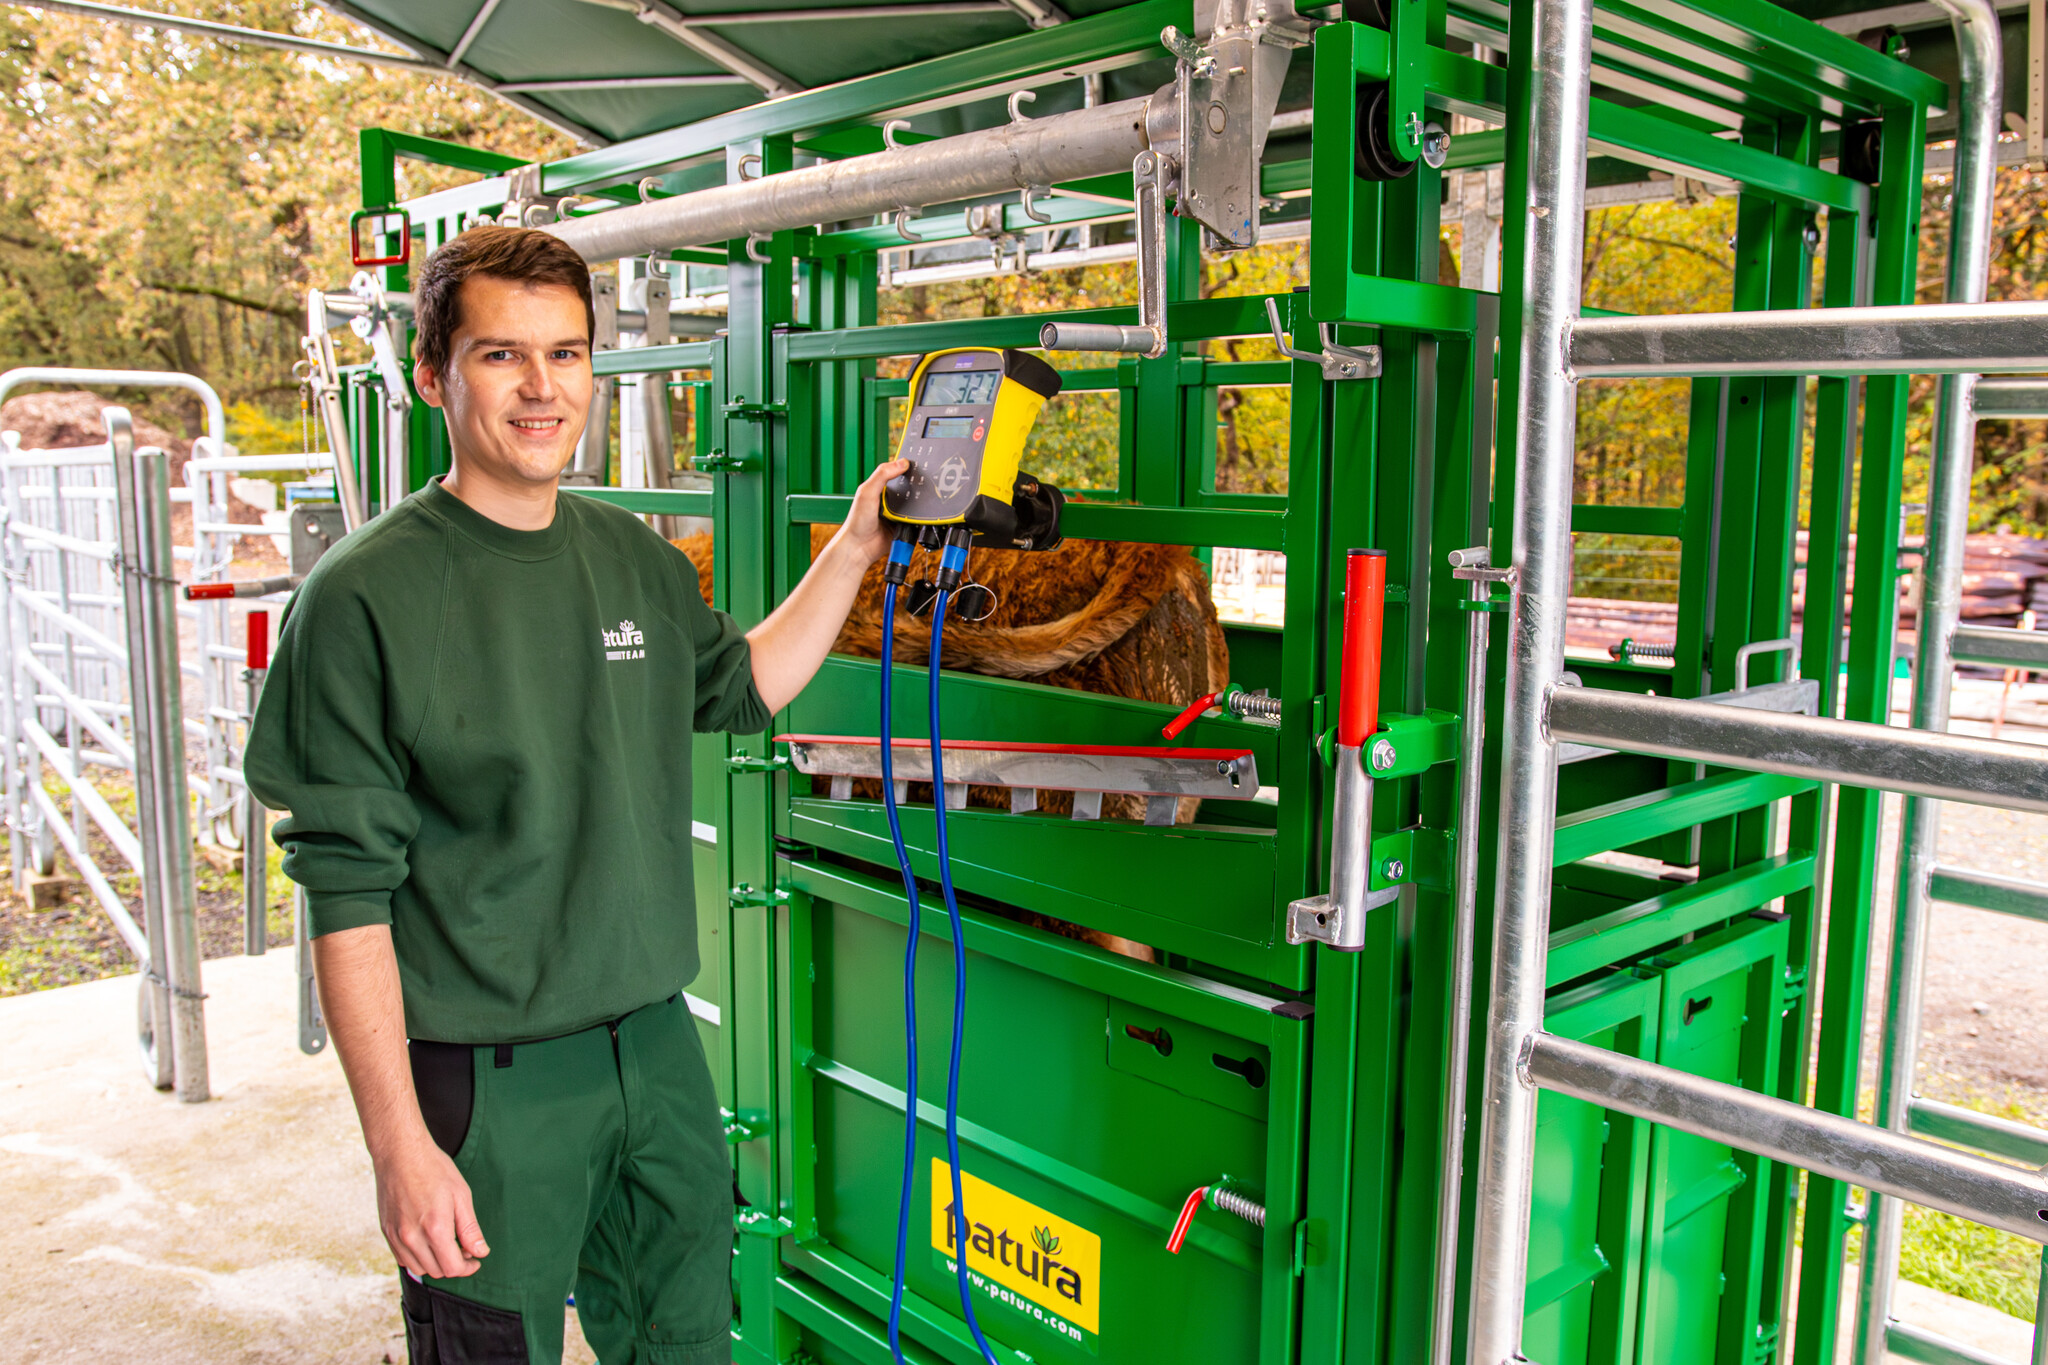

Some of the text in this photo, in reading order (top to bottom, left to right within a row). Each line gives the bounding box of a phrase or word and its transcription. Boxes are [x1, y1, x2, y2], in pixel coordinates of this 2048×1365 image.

[953, 373, 997, 404] 327
[602, 628, 644, 647] atura
[946, 1259, 1082, 1342] ww.patura.com
